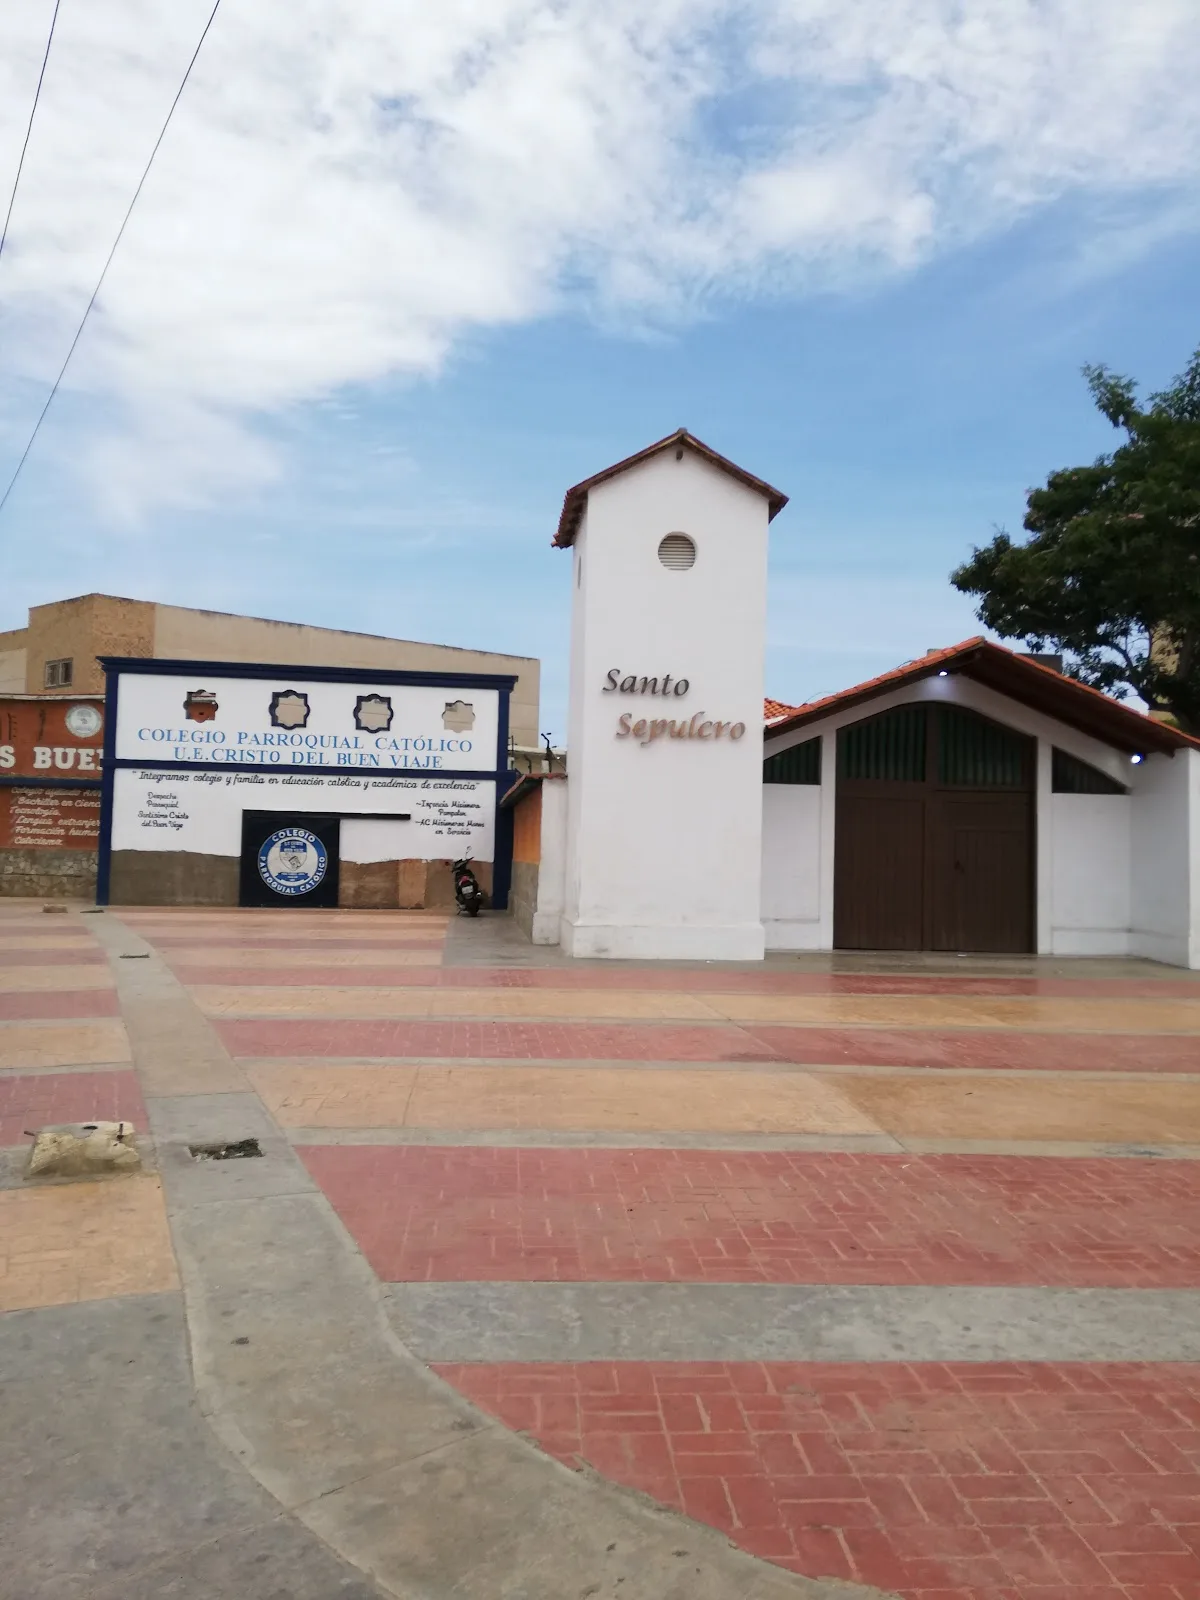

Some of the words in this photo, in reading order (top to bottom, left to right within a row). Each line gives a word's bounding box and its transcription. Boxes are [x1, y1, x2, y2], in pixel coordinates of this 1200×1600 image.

[602, 668, 690, 697] Santo
[138, 728, 226, 744] COLEGIO
[237, 731, 364, 749] PARROQUIAL
[375, 735, 473, 752] CATÓLICO
[616, 711, 746, 746] Sepulcro
[33, 746, 104, 771] BUE
[292, 751, 329, 764] DEL
[337, 753, 380, 766] BUEN
[390, 755, 443, 768] VIAJE
[193, 775, 223, 785] colegio
[225, 776, 232, 785] y
[233, 774, 265, 785] familia
[282, 776, 324, 785] educación
[327, 779, 362, 787] católica
[363, 781, 370, 790] y
[371, 780, 417, 789] académica
[421, 780, 431, 789] de
[271, 829, 316, 842] COLEGIO
[260, 856, 296, 893] PARROQUIAL
